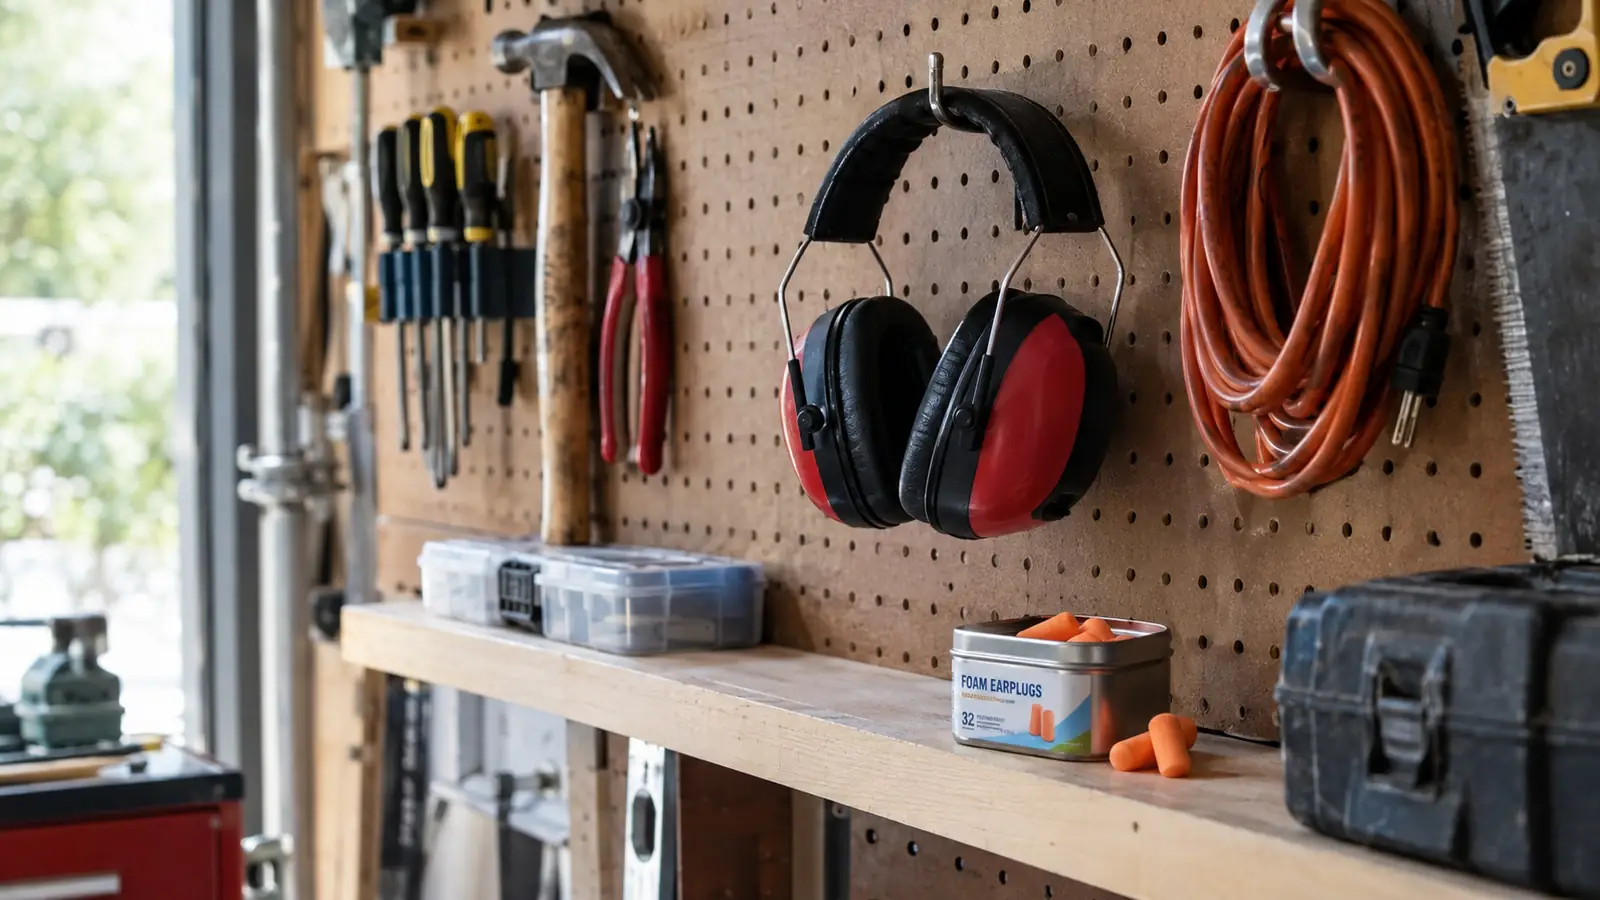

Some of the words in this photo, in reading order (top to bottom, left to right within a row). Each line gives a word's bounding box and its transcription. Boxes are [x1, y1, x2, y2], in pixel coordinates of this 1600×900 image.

[961, 675, 987, 691] FOAM
[991, 679, 1042, 698] EARPLUGS
[962, 711, 975, 727] 32
